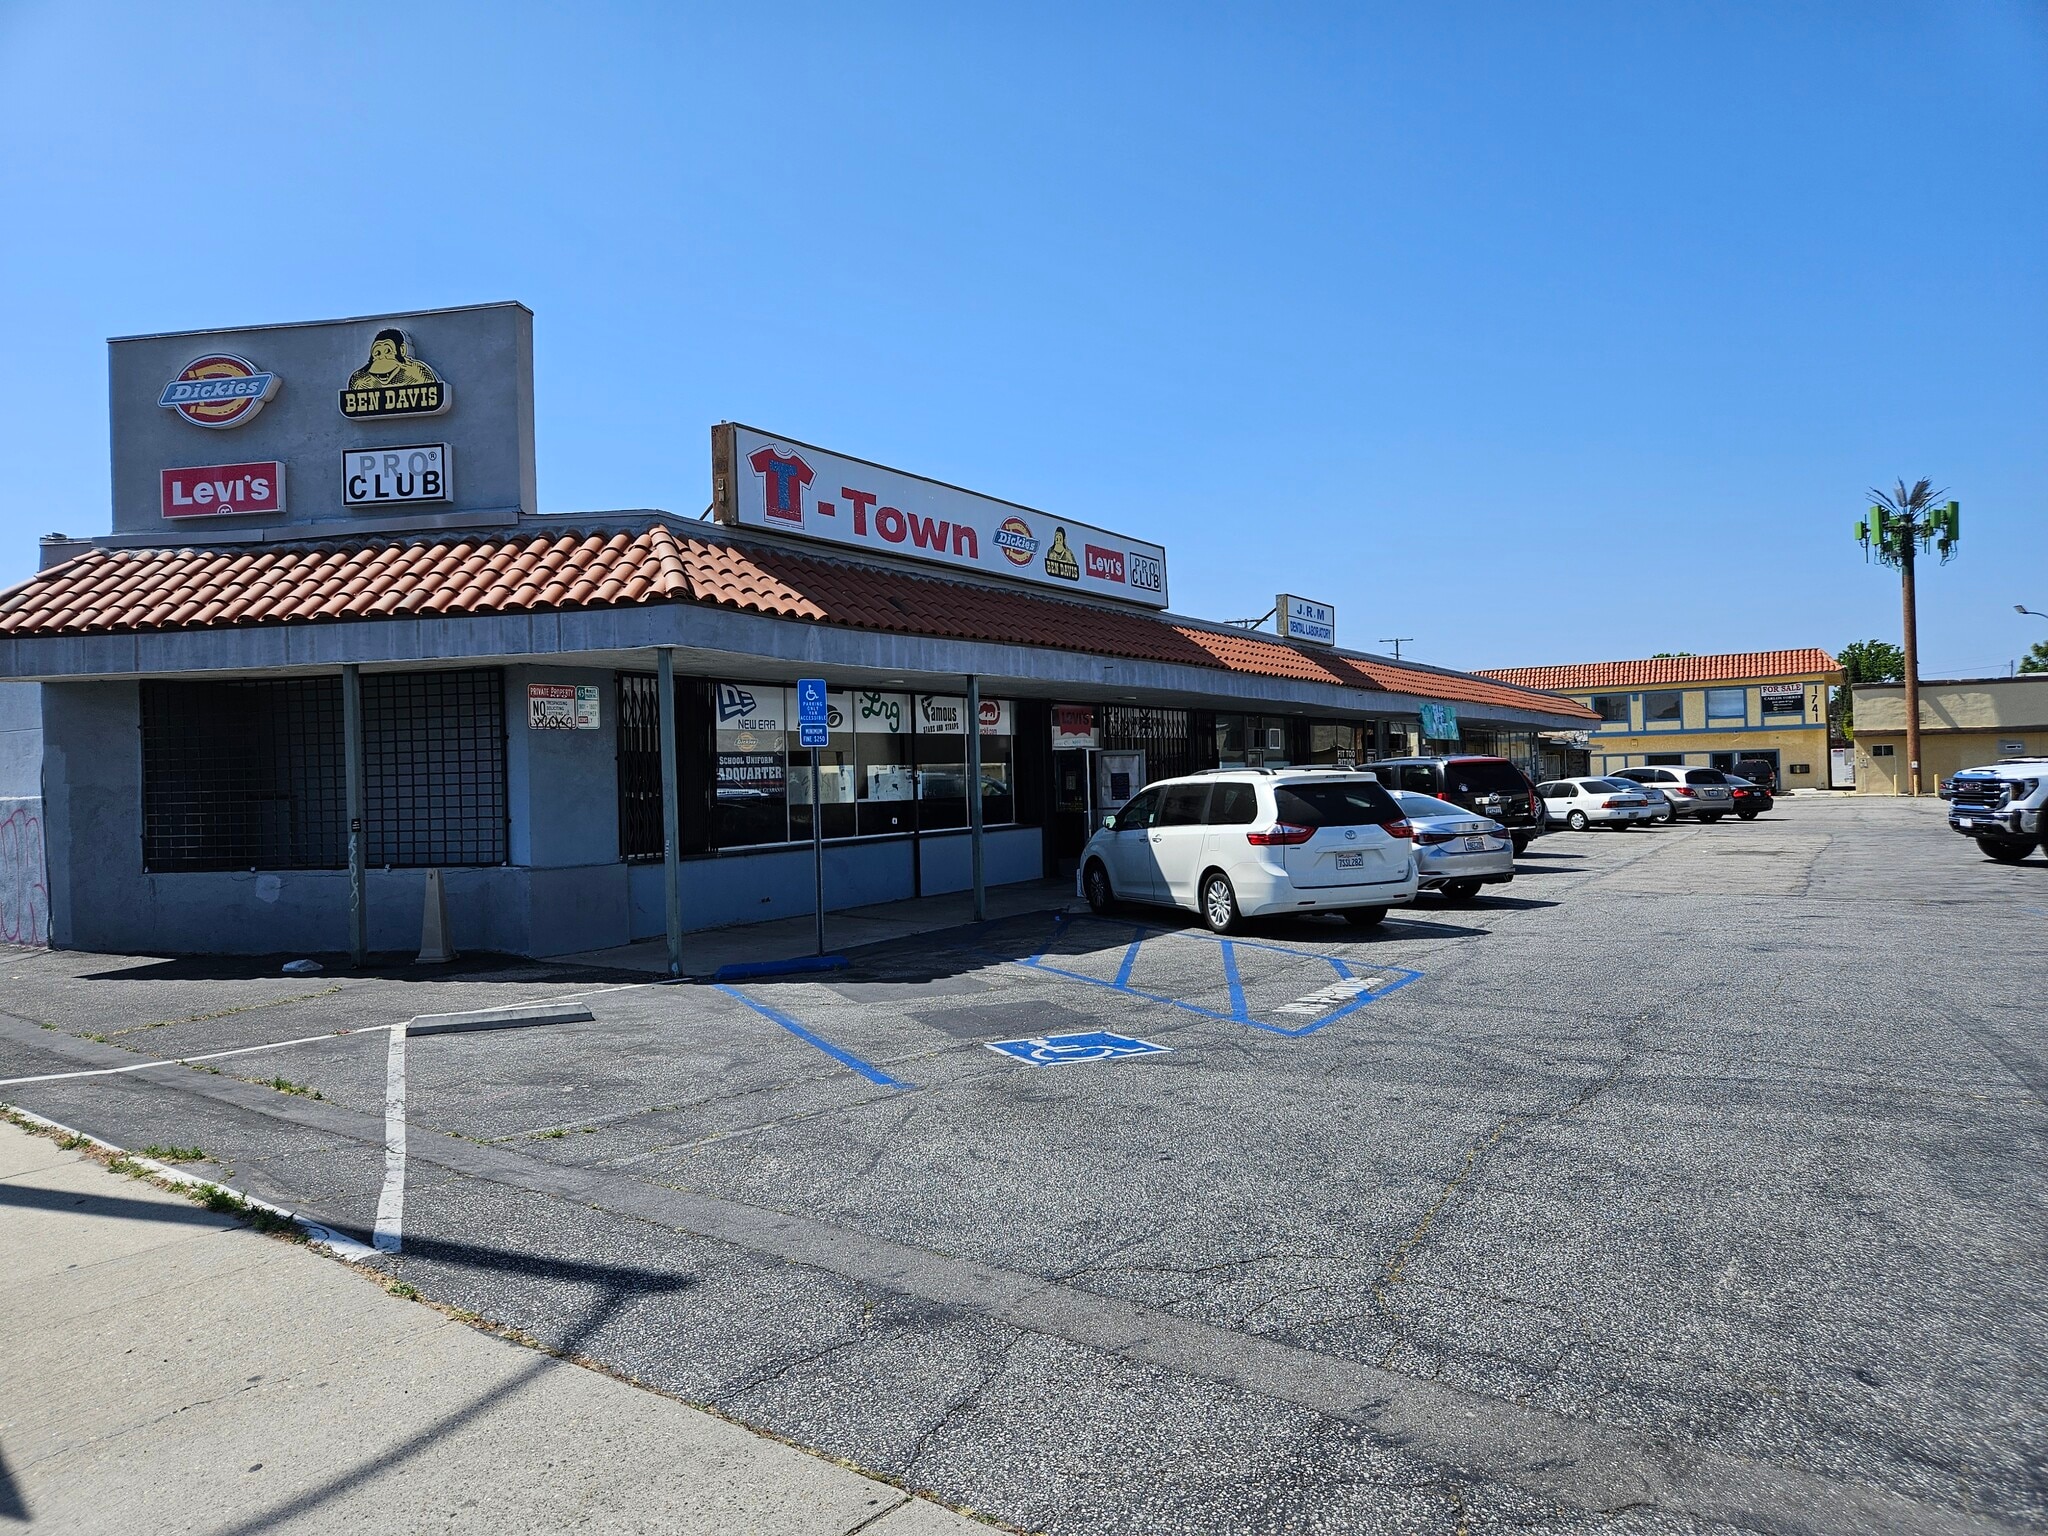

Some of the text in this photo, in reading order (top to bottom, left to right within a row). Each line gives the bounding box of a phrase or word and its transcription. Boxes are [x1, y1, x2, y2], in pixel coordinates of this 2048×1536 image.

[170, 380, 260, 401] Dickies
[345, 386, 438, 413] BEN DAVIS
[359, 451, 429, 479] PRO
[172, 474, 270, 506] Levi's
[348, 470, 441, 500] CLUB
[998, 533, 1036, 551] Dickies
[1046, 560, 1078, 578] BEN DAVIS
[1088, 552, 1122, 576] Levi's
[1135, 557, 1155, 576] PRO
[1132, 568, 1160, 589] CLUB
[1290, 620, 1331, 640] DENTAL LABORATORY
[530, 687, 574, 698] PRIVATE PROPERTY
[1762, 685, 1779, 693] FOR
[1780, 684, 1802, 692] SALE
[533, 700, 546, 717] NO
[738, 719, 776, 730] NEW ERA
[803, 735, 813, 743] FINE
[719, 755, 774, 765] SCHOOL UNIFORM
[717, 766, 784, 781] ADQUARTER
